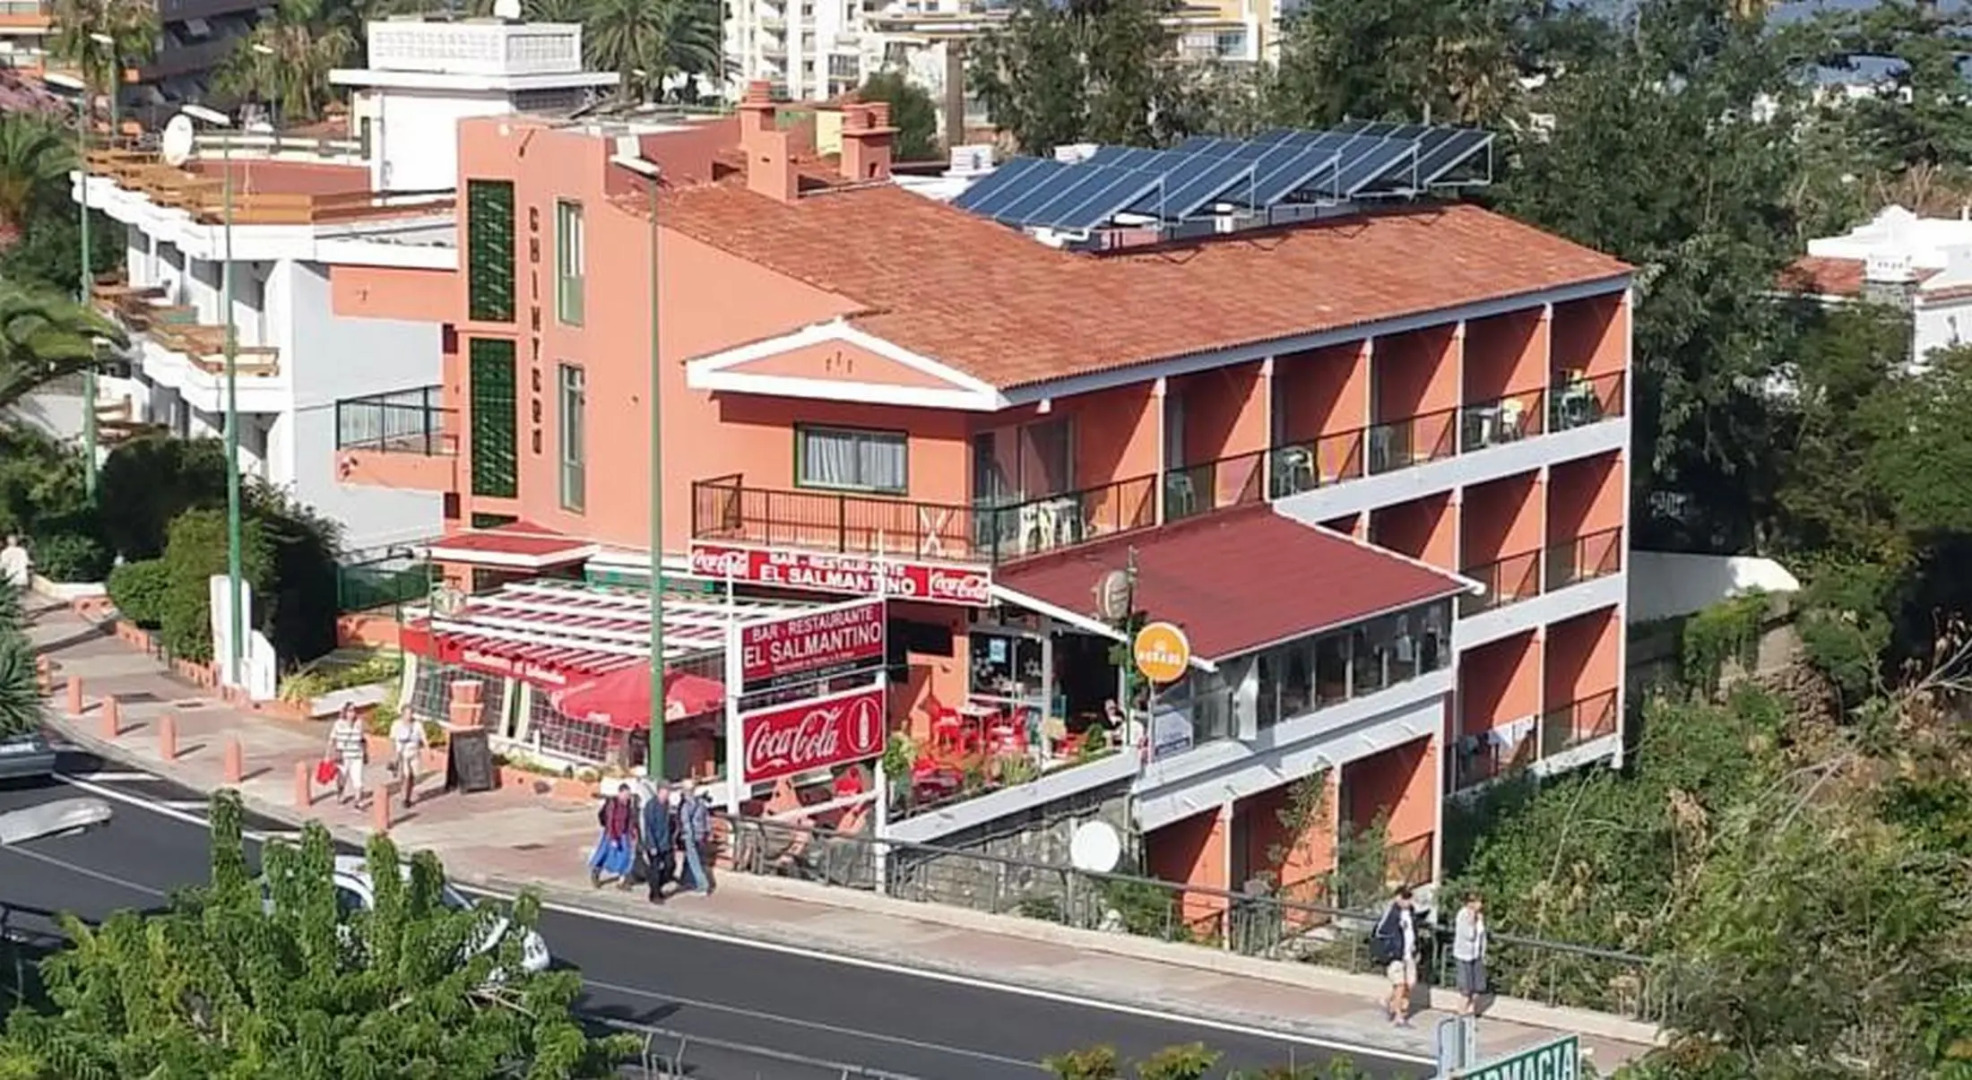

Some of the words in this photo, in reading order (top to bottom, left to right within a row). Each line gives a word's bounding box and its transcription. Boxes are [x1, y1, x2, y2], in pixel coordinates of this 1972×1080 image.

[760, 563, 786, 584] EL
[788, 567, 917, 596] SALMANTNO
[752, 625, 779, 642] BAR
[788, 606, 874, 637] RESTAURANTE
[744, 646, 767, 669] EL
[770, 622, 882, 664] SALMANTINO
